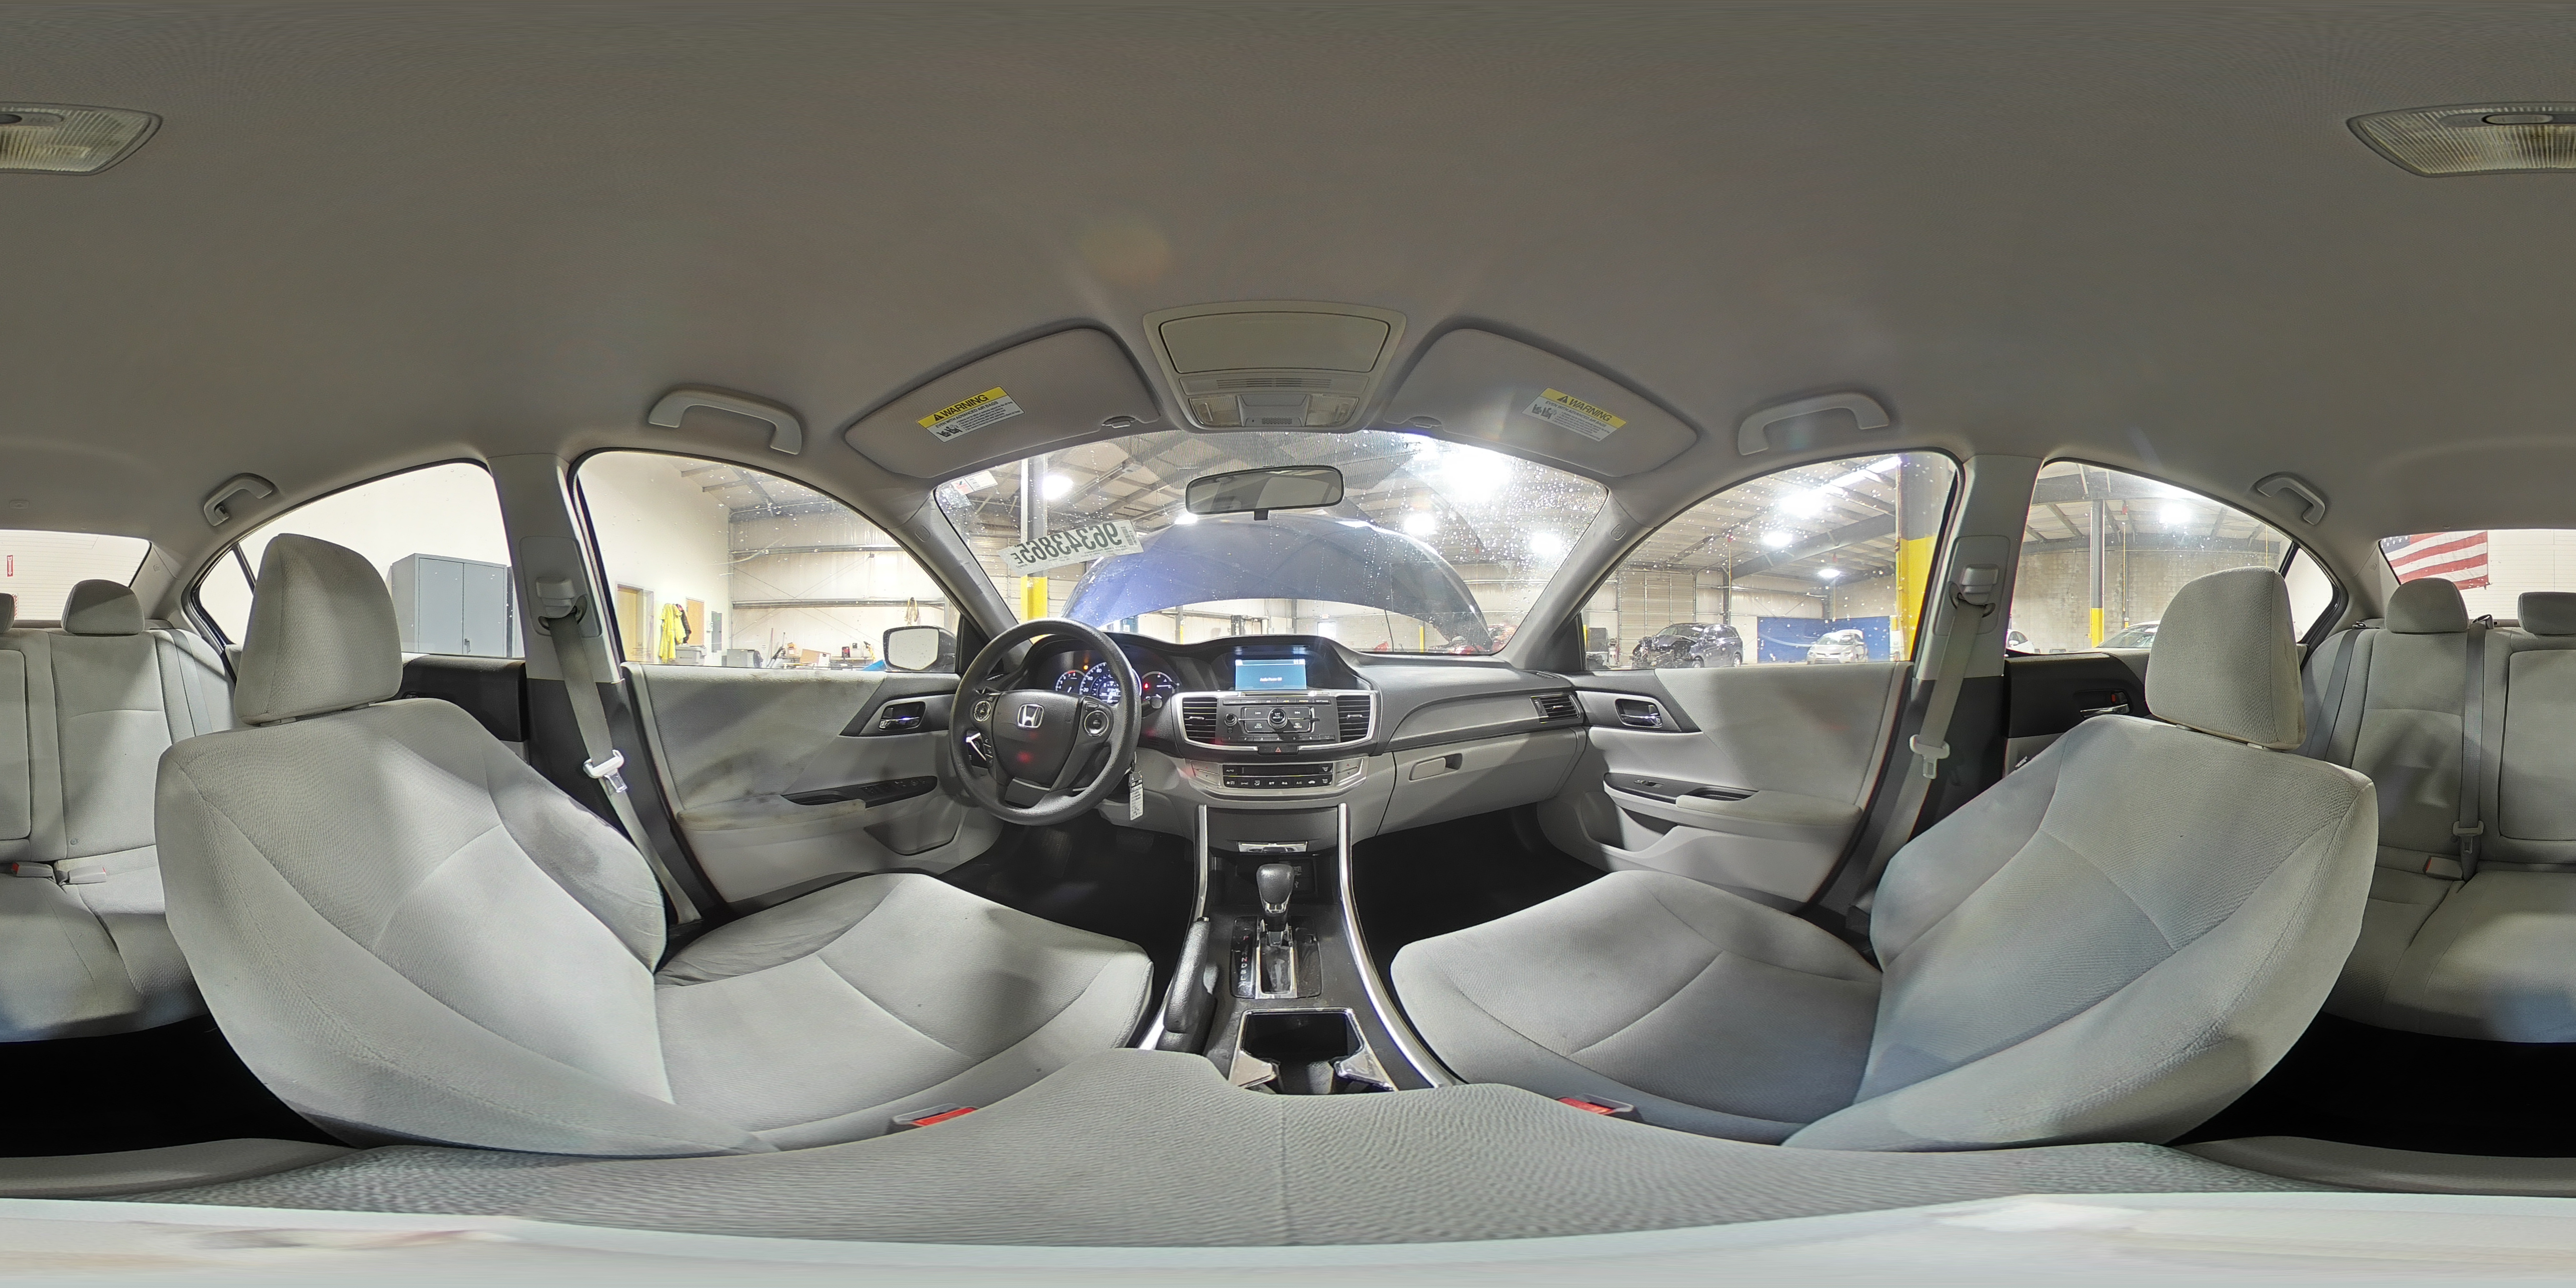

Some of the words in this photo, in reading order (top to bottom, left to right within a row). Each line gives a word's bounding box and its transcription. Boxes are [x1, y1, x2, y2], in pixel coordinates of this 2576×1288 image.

[940, 394, 989, 417] WARNING
[1569, 399, 1612, 422] WARNING
[955, 409, 978, 420] ADVANCED
[1568, 409, 1590, 421] ADVANCED
